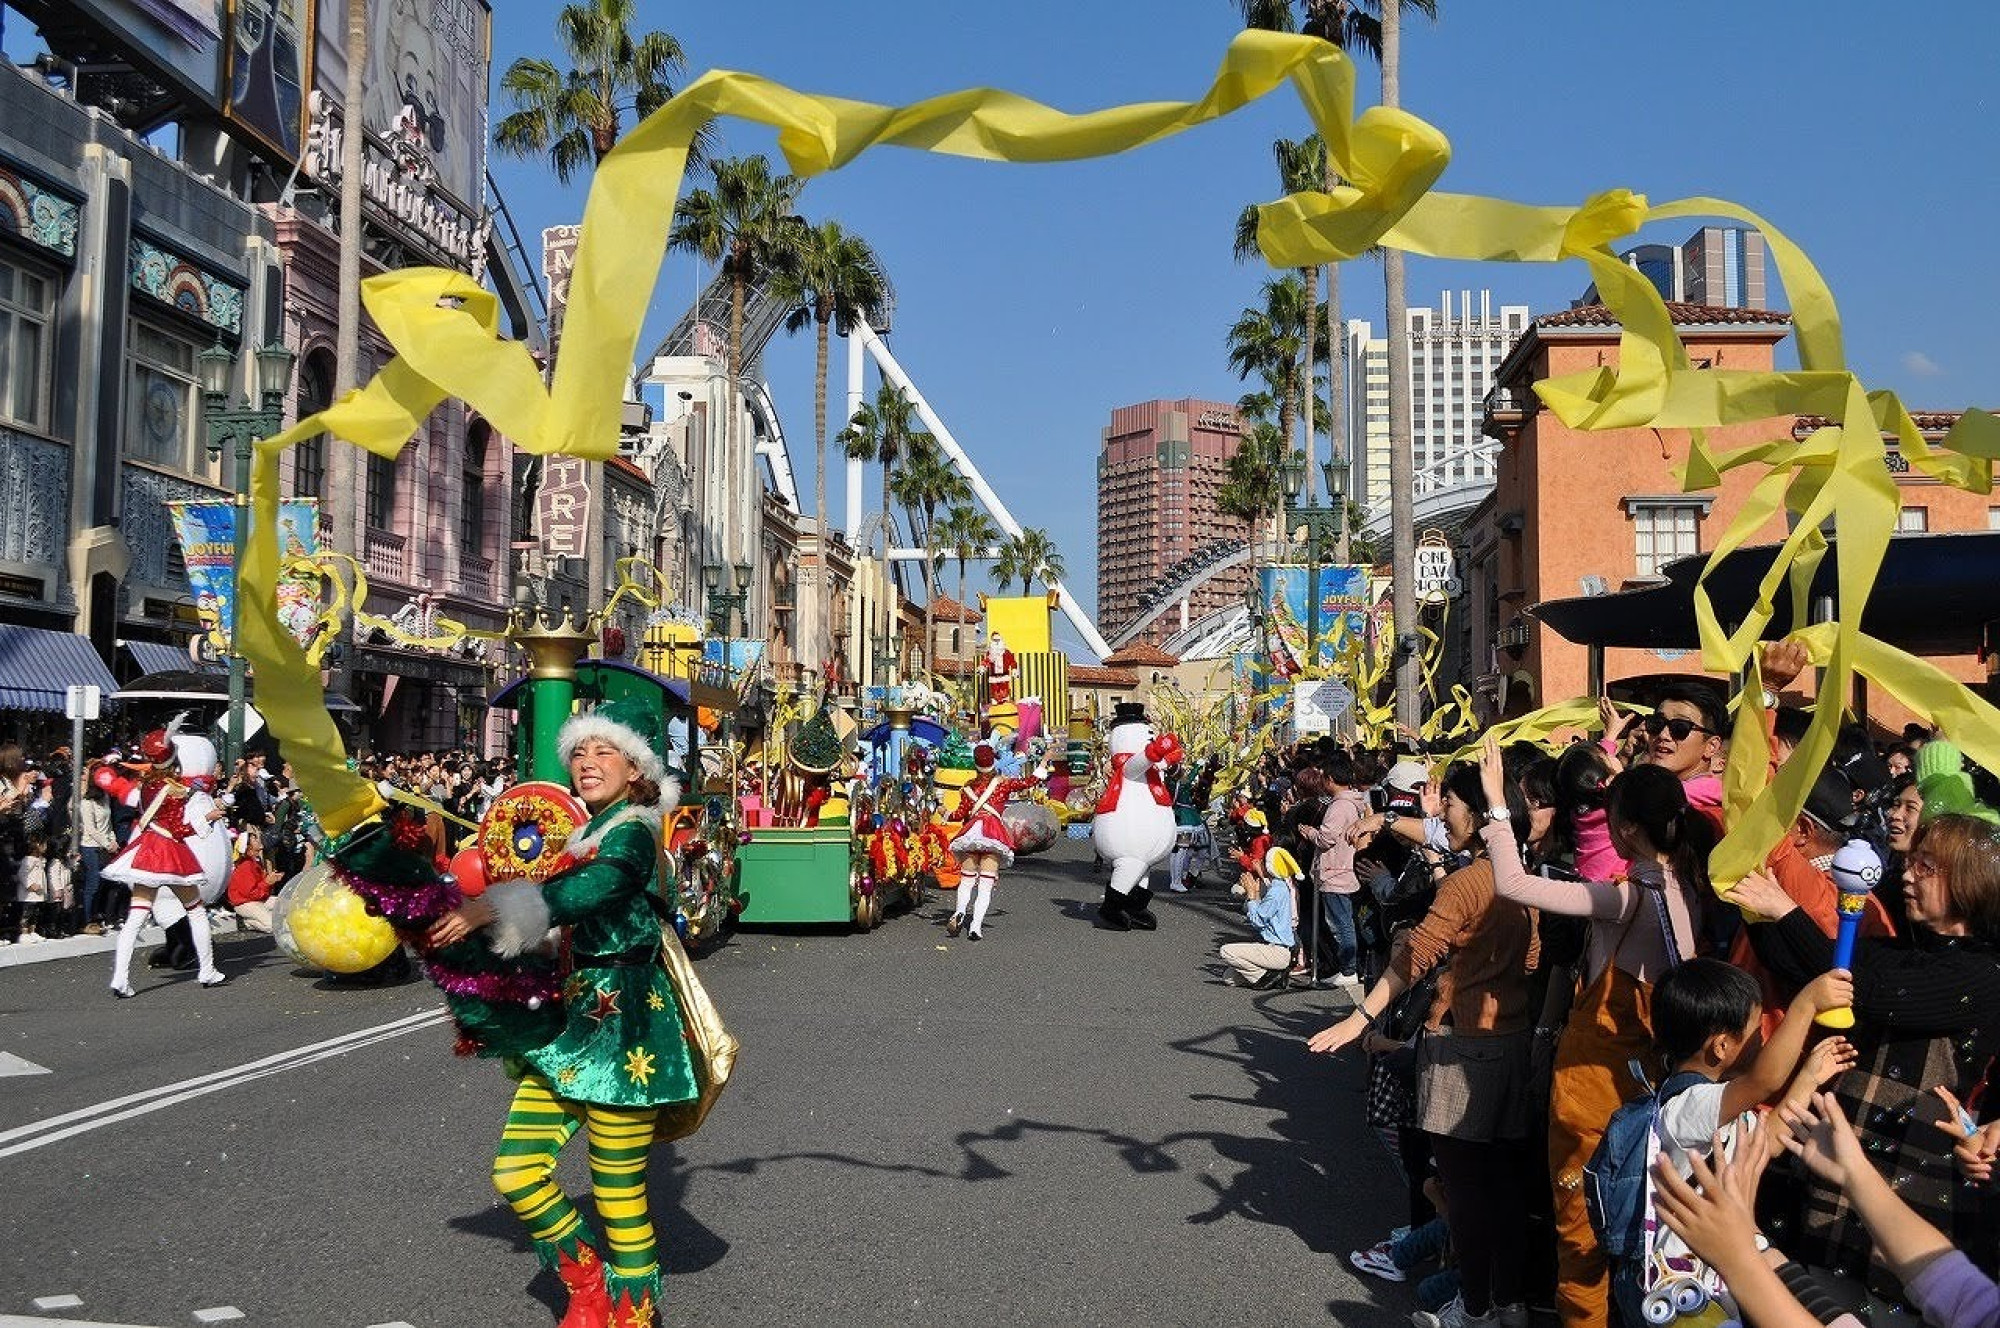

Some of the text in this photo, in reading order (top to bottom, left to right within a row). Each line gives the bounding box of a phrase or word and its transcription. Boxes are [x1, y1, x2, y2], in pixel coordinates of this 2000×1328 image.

[549, 453, 576, 550] TRE
[1419, 551, 1447, 564] ONE
[1420, 565, 1446, 578] DAY
